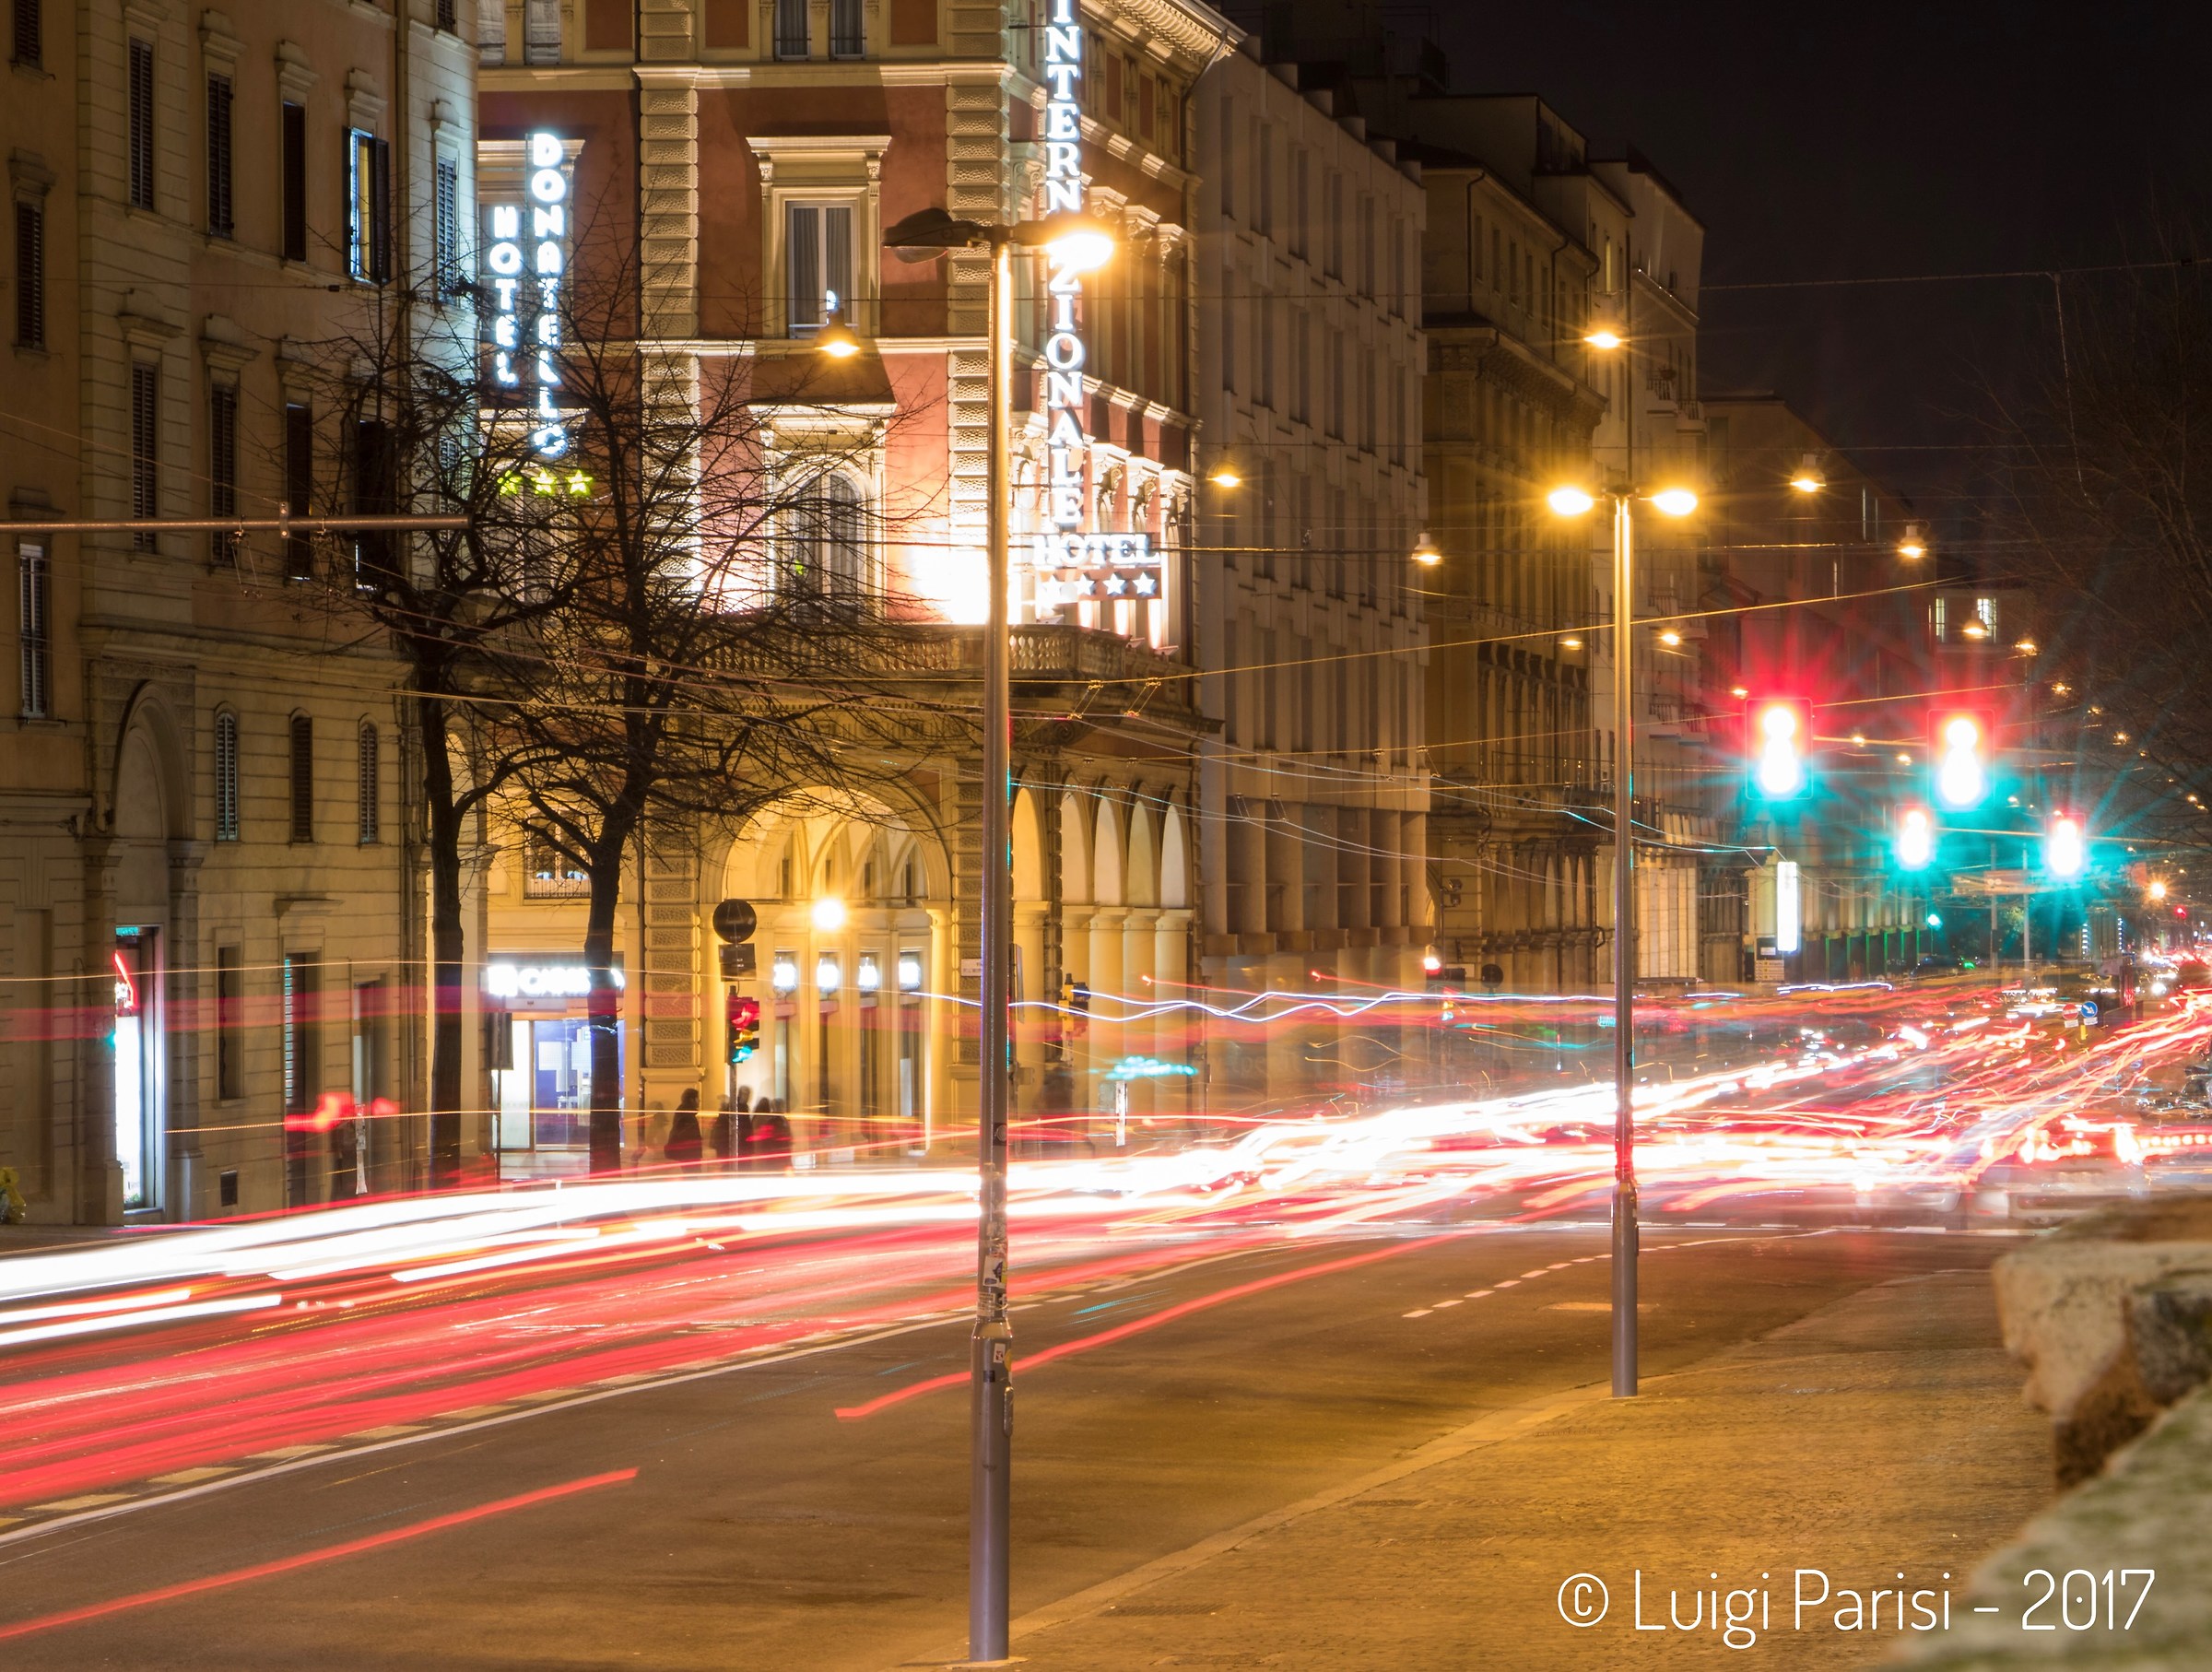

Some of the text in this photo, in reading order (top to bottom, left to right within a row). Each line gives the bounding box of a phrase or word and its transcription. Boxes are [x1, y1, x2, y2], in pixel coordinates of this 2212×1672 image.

[488, 206, 523, 384] HOTEL
[531, 132, 566, 455] DONATELLO
[1045, 0, 1085, 525] INTERNZIONALE
[1031, 534, 1161, 565] HOTEL
